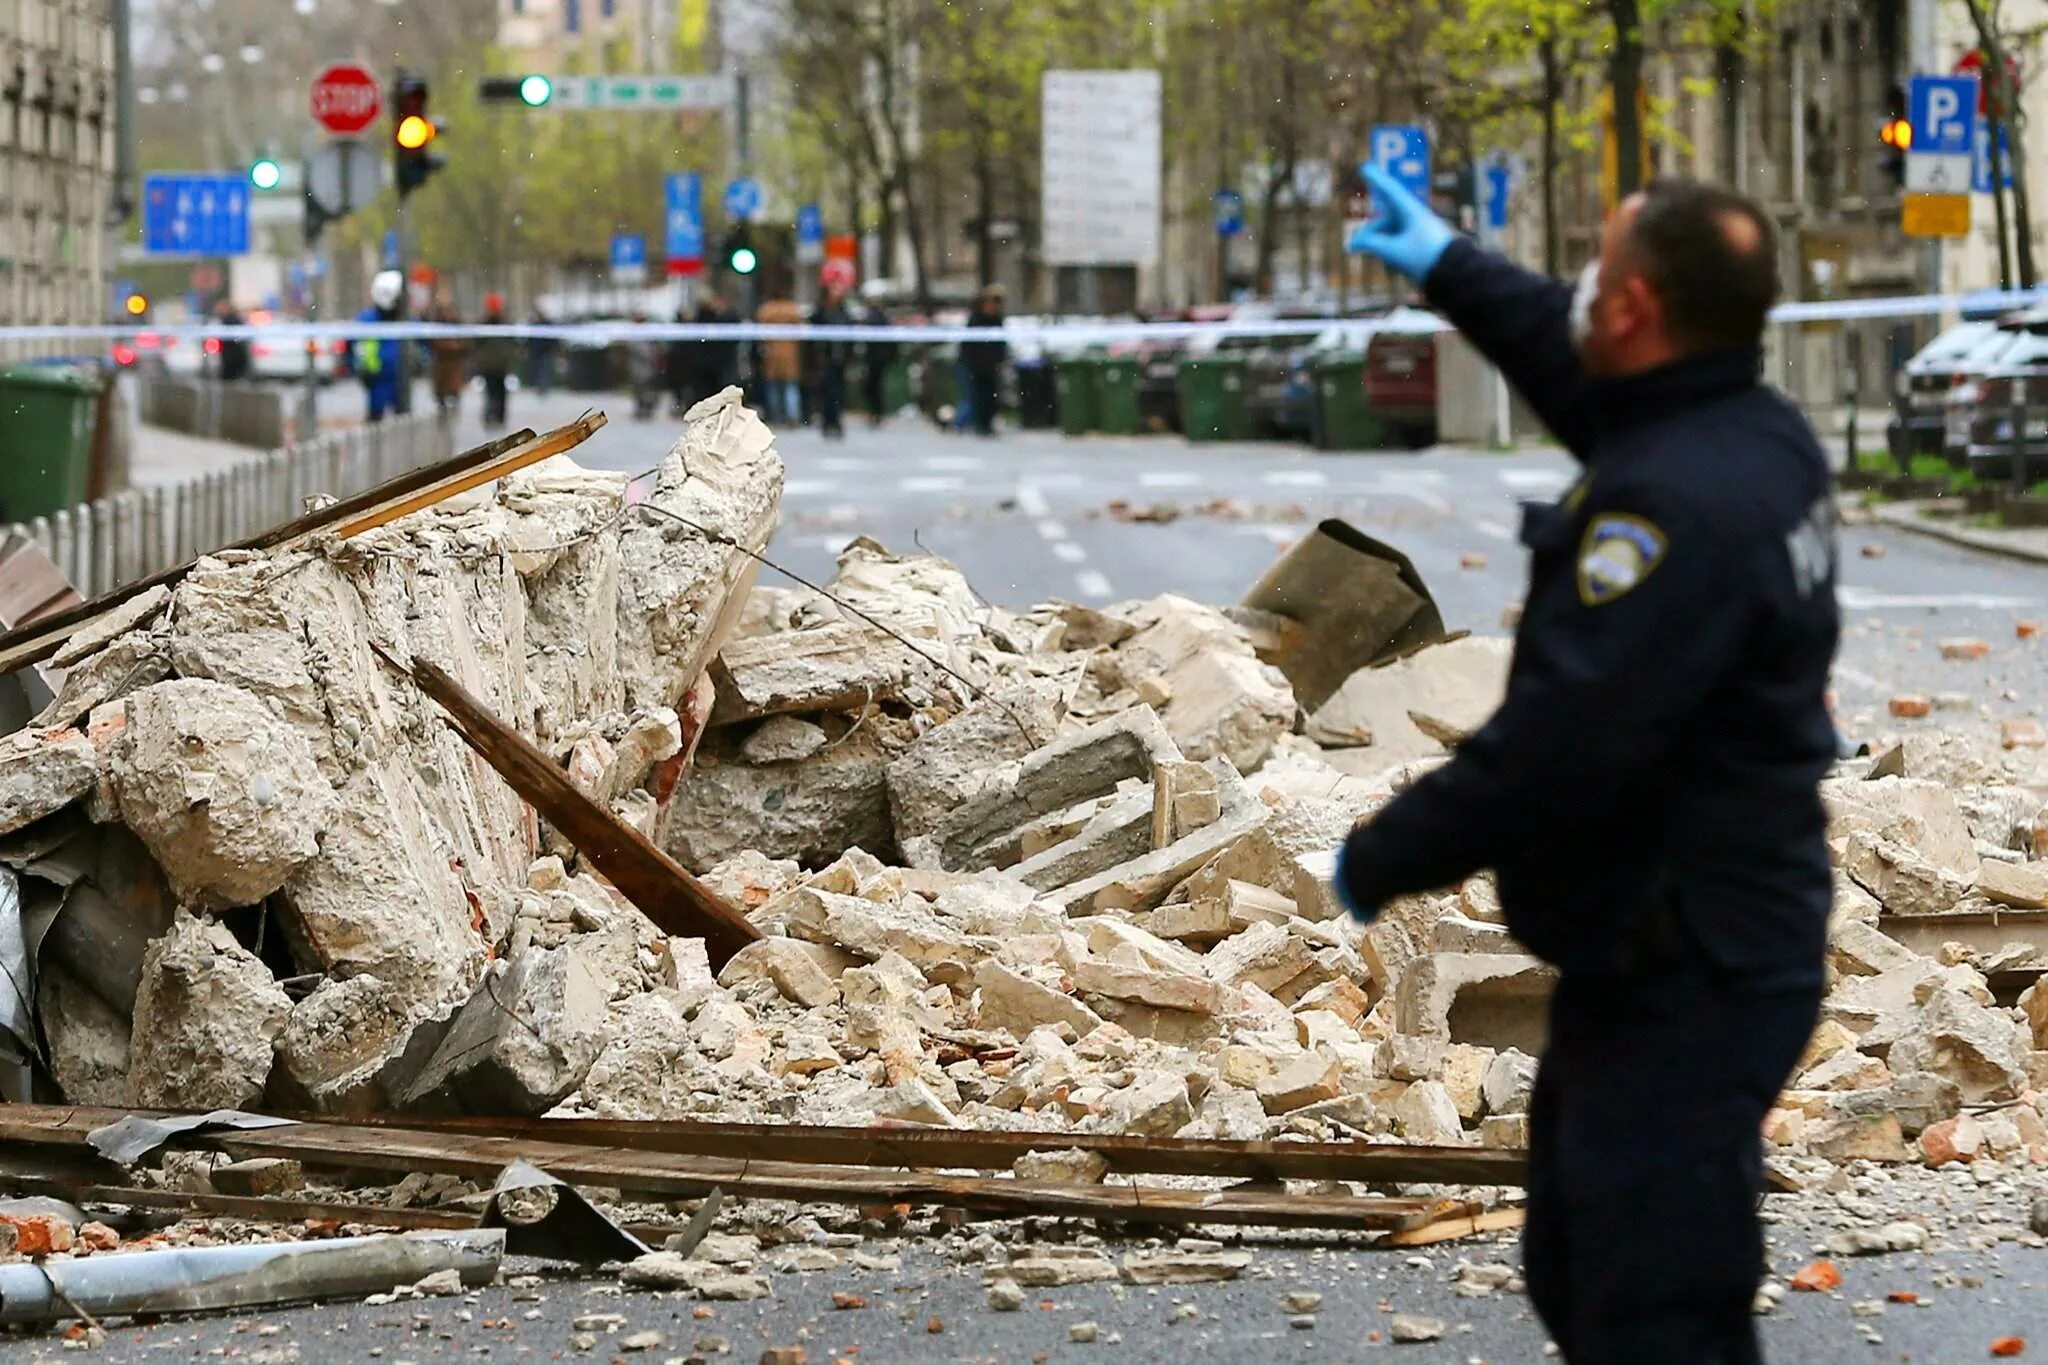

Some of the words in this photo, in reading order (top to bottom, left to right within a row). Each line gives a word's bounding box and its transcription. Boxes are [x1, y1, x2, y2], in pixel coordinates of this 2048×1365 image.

[316, 83, 376, 116] STOP
[1927, 86, 1958, 138] P
[1378, 131, 1405, 172] P
